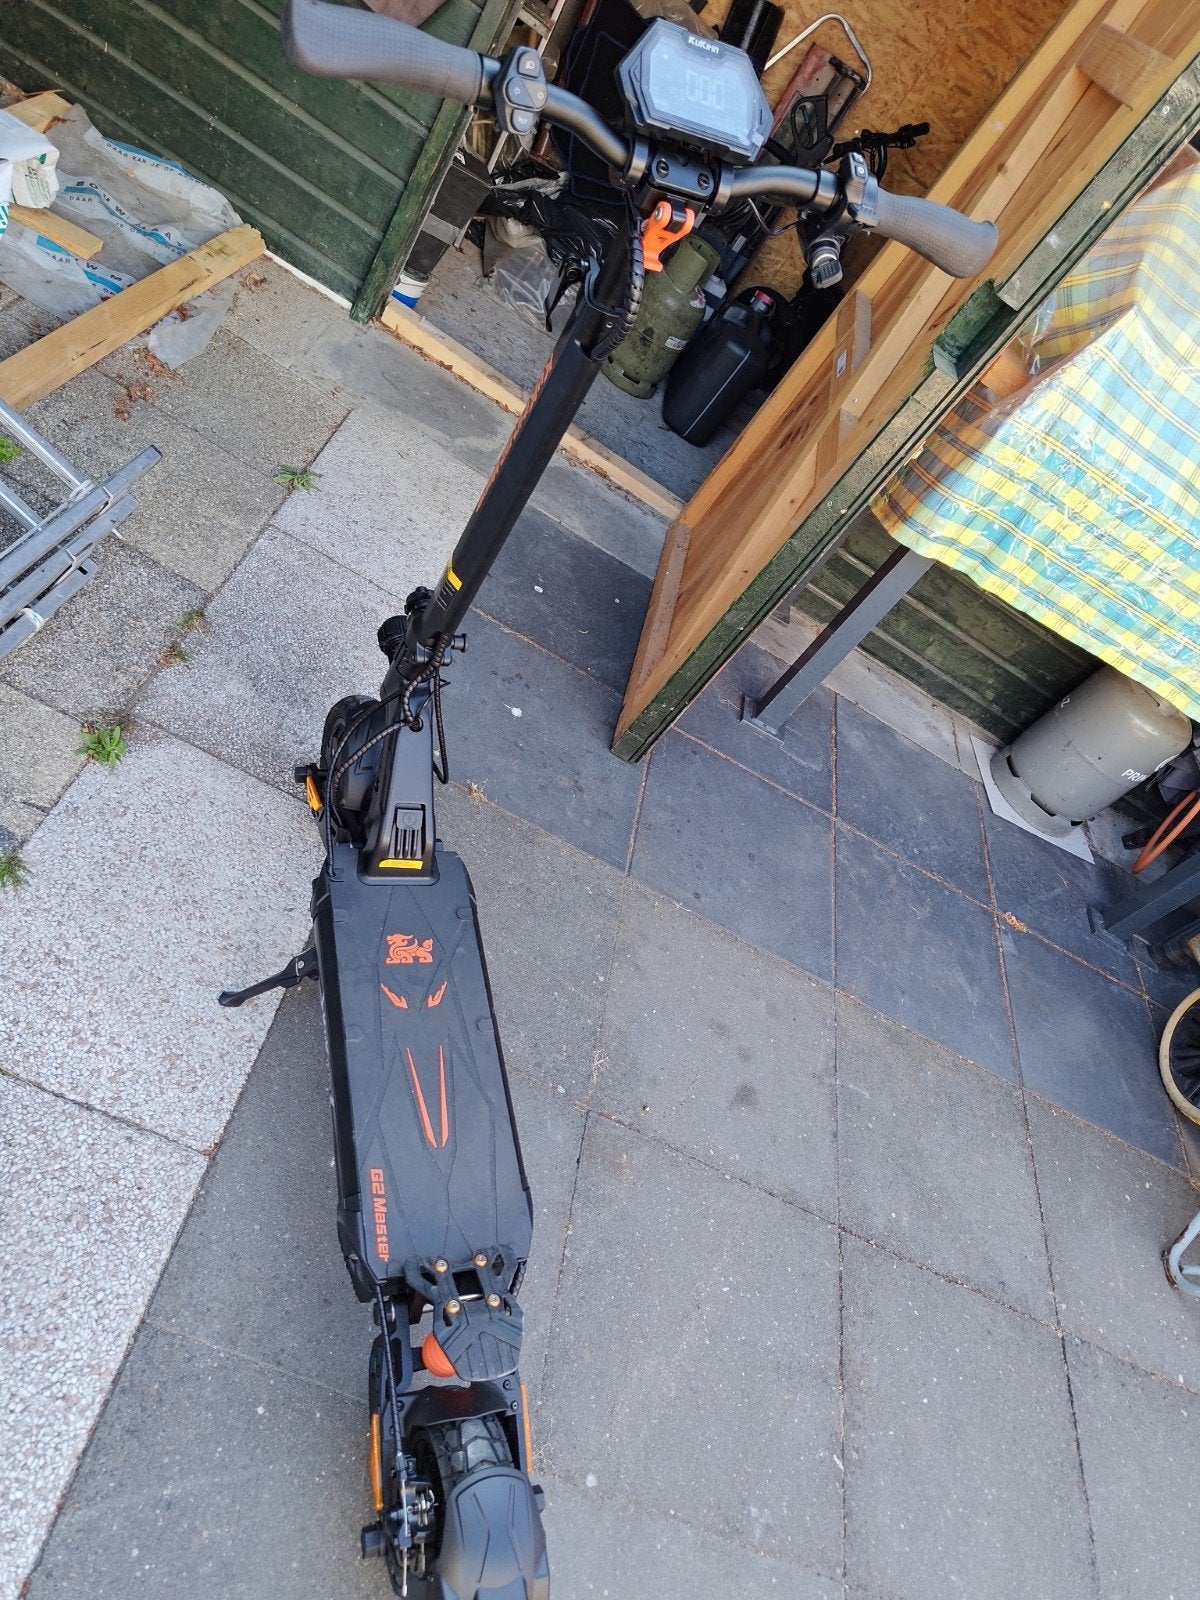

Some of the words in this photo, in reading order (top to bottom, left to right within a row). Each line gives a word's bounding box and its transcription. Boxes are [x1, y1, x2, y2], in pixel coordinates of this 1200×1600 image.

[106, 142, 129, 158] DAAR
[132, 155, 147, 164] KAN
[373, 1197, 390, 1262] Master
